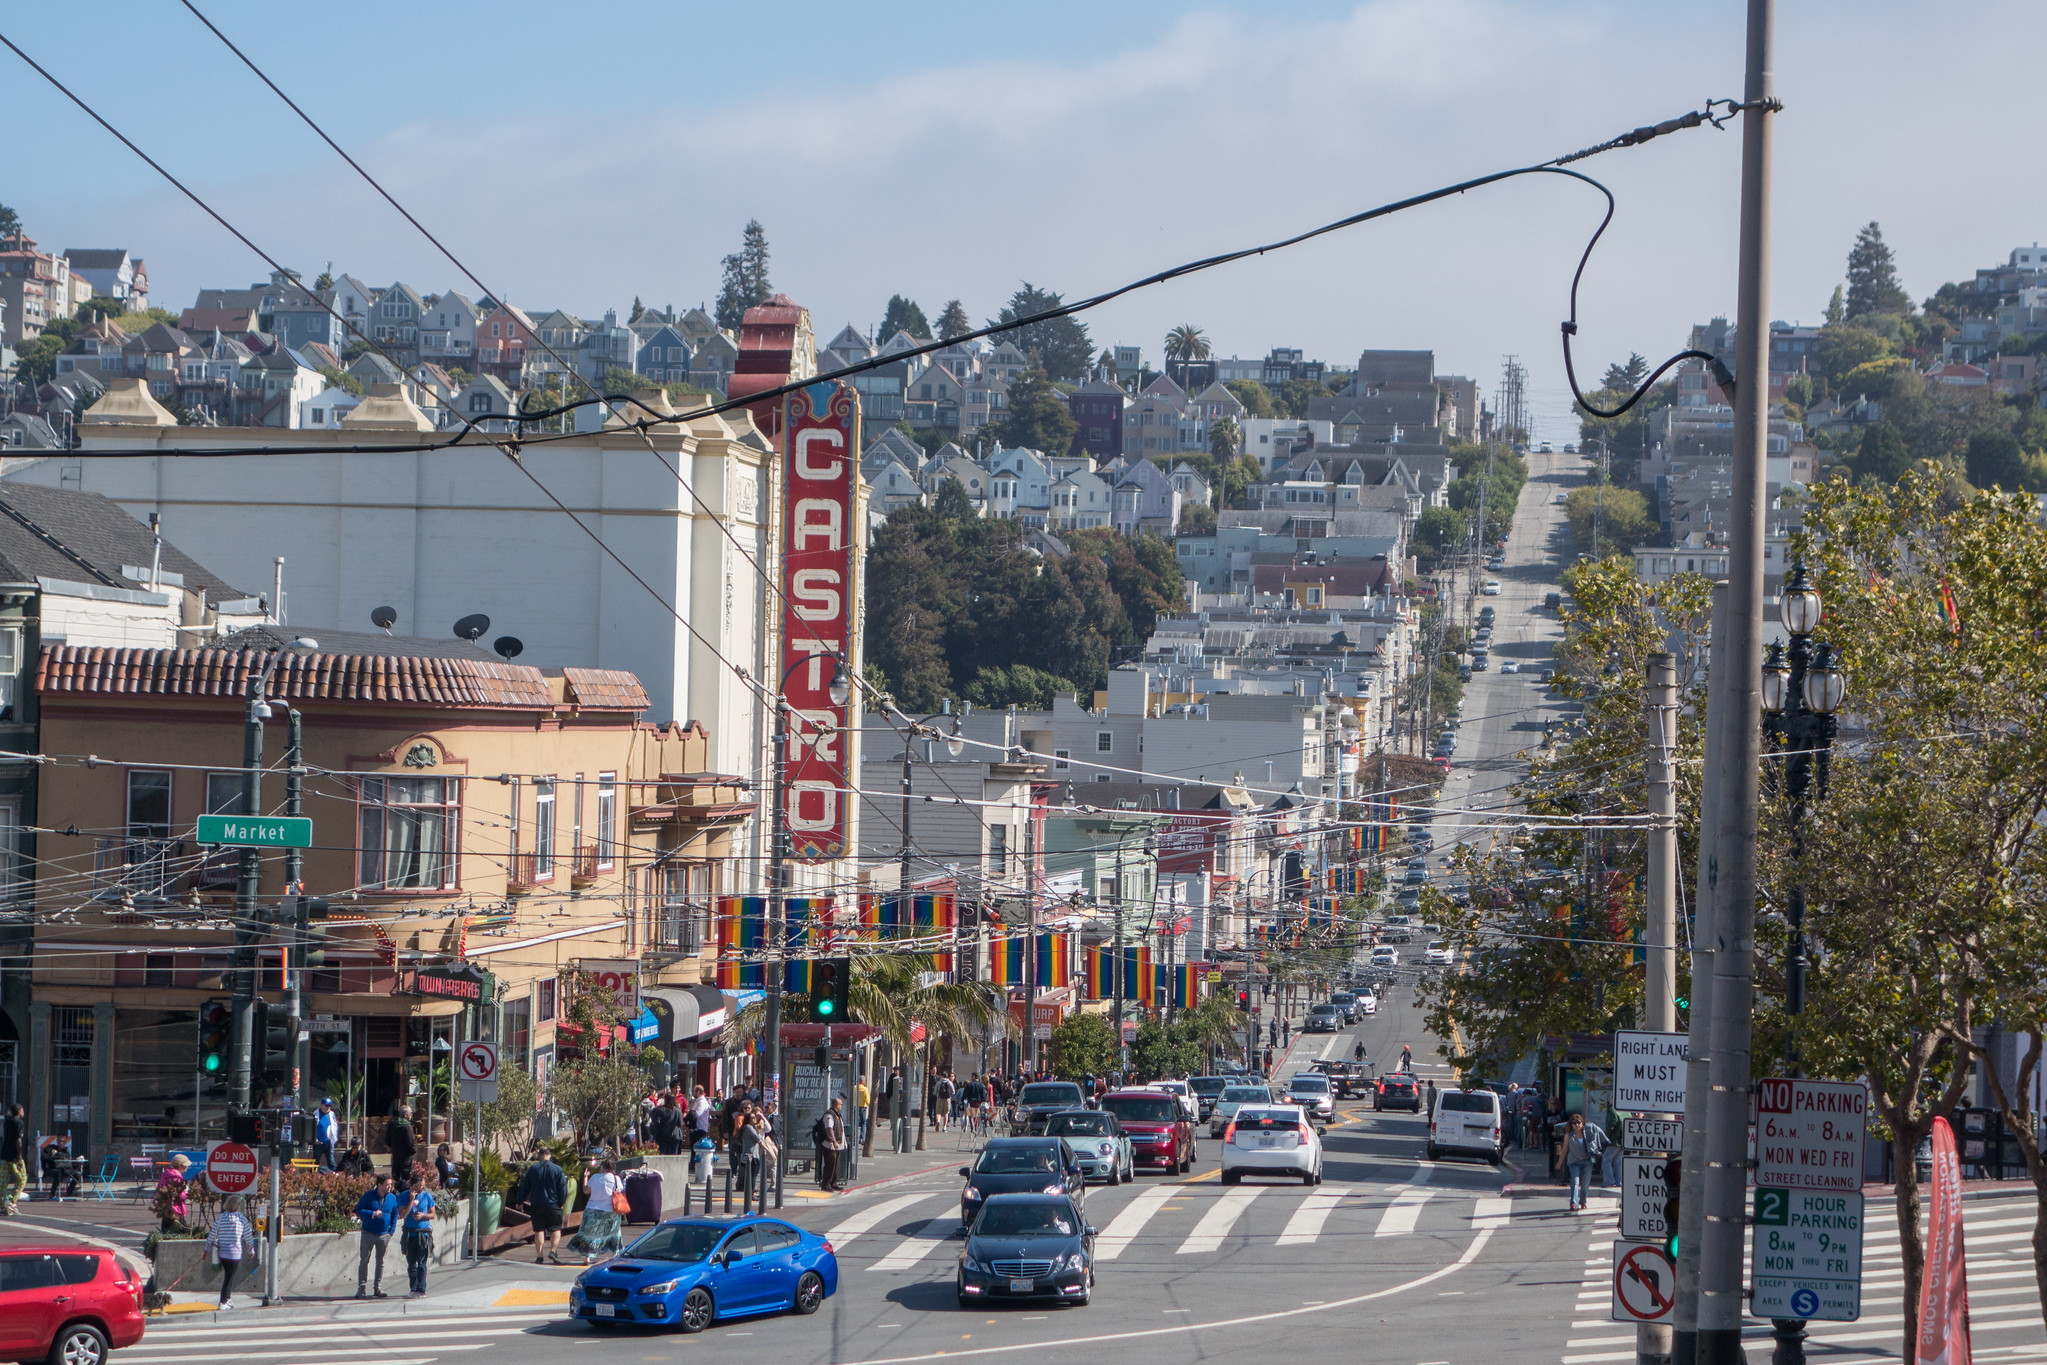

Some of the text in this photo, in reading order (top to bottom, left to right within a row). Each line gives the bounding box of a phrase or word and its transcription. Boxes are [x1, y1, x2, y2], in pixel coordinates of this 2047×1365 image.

[788, 427, 844, 833] CASTRO
[1173, 817, 1201, 825] ACTORY
[224, 823, 285, 840] Market
[418, 975, 481, 999] TWIN PEAKS
[1621, 1041, 1656, 1056] RIGHT
[795, 1065, 820, 1077] BUCKLE
[1634, 1064, 1677, 1081] MUST
[794, 1088, 804, 1099] AN
[805, 1088, 824, 1099] EASY
[1619, 1088, 1650, 1102] TURN
[1761, 1082, 1863, 1115] NO PARKING
[1628, 1121, 1679, 1136] EXCEPT
[1807, 1123, 1816, 1131] TO
[1632, 1135, 1674, 1150] MUNI
[214, 1151, 251, 1161] DO NOT
[1765, 1146, 1854, 1169] MON WED FRI
[216, 1173, 247, 1183] ENTER
[1638, 1164, 1665, 1180] NO
[1763, 1172, 1801, 1185] STREET
[1804, 1174, 1854, 1188] CLEANING
[1634, 1184, 1667, 1198] TURN
[1641, 1201, 1661, 1215] ON
[1761, 1192, 1847, 1219] 2 HOUR
[1639, 1219, 1665, 1232] RED
[1791, 1212, 1858, 1230] PARKING
[1802, 1232, 1813, 1240] TO
[1765, 1255, 1849, 1273] MON THRU FRI
[1758, 1279, 1853, 1291] EXCEPT VEHICLES WITH
[1762, 1292, 1854, 1313] AREA S PERMITS
